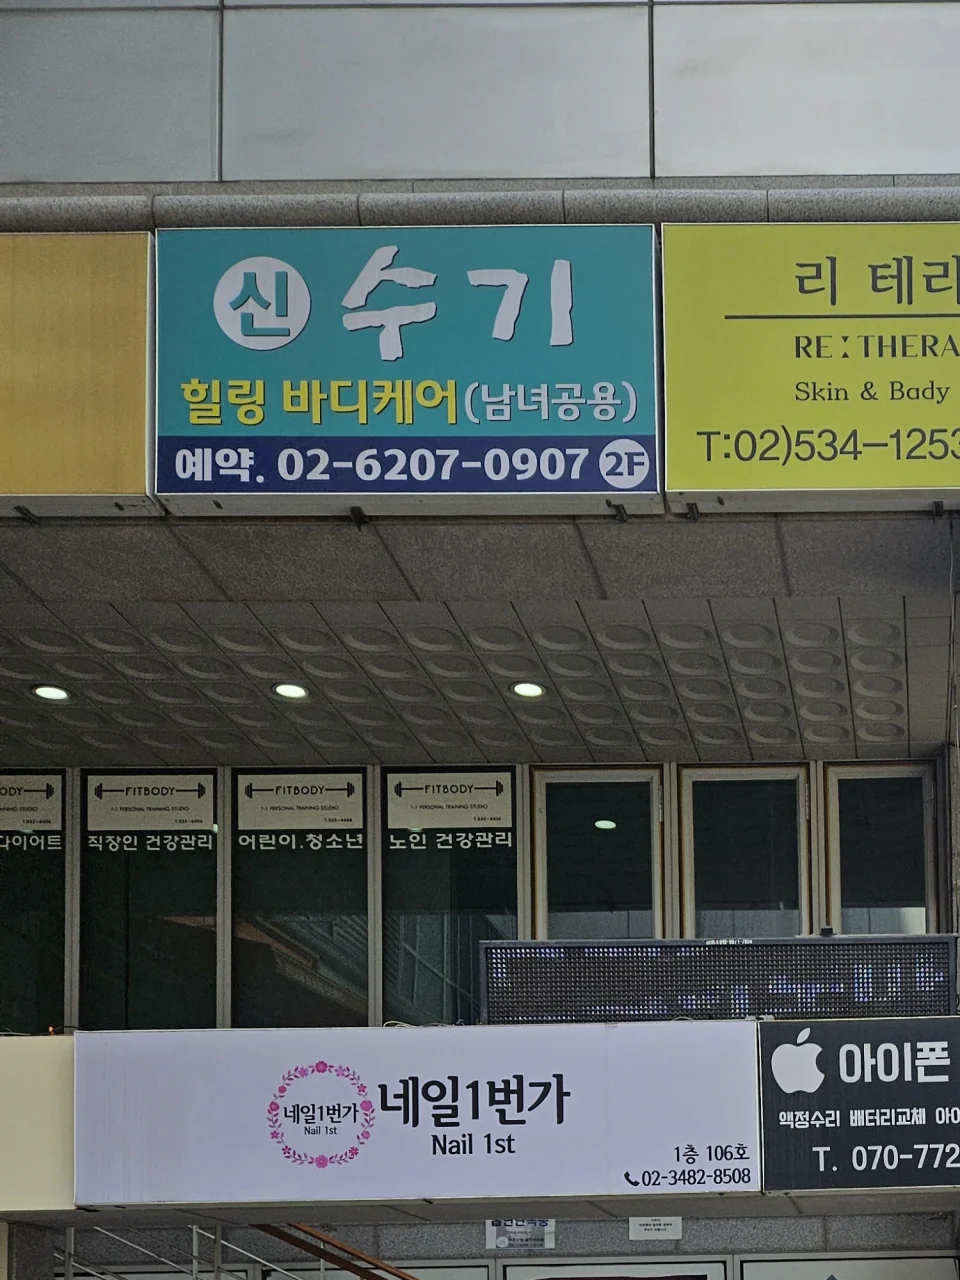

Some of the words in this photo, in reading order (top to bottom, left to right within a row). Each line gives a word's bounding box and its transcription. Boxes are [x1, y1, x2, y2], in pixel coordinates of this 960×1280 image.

[795, 255, 838, 306] 리
[229, 270, 292, 338] 신
[181, 379, 266, 425] 힐링
[795, 381, 849, 402] Skin
[860, 381, 880, 401] &
[277, 447, 590, 481] 02-6207-0907
[605, 450, 648, 477] 2F
[125, 786, 176, 796] FITBODY
[275, 785, 325, 795] FITBODY
[425, 784, 474, 794] FITBODY
[88, 835, 138, 851] 직장인
[146, 834, 213, 850] 건강관리
[389, 832, 427, 850] 노인
[436, 831, 512, 850] 건강관리
[839, 1040, 951, 1083] 아이폰
[378, 1073, 571, 1129] 네일1번가
[283, 1103, 360, 1125] 네일1번가
[779, 1110, 840, 1129] 액정수리
[850, 1108, 926, 1127] 배터리교체
[304, 1126, 323, 1136] Nail
[324, 1126, 338, 1135] 1st
[432, 1134, 473, 1156] Nail
[484, 1133, 516, 1155] 1st
[674, 1145, 699, 1164] 1층
[706, 1142, 751, 1163] 106호
[641, 1168, 751, 1187] 02-3482-8508
